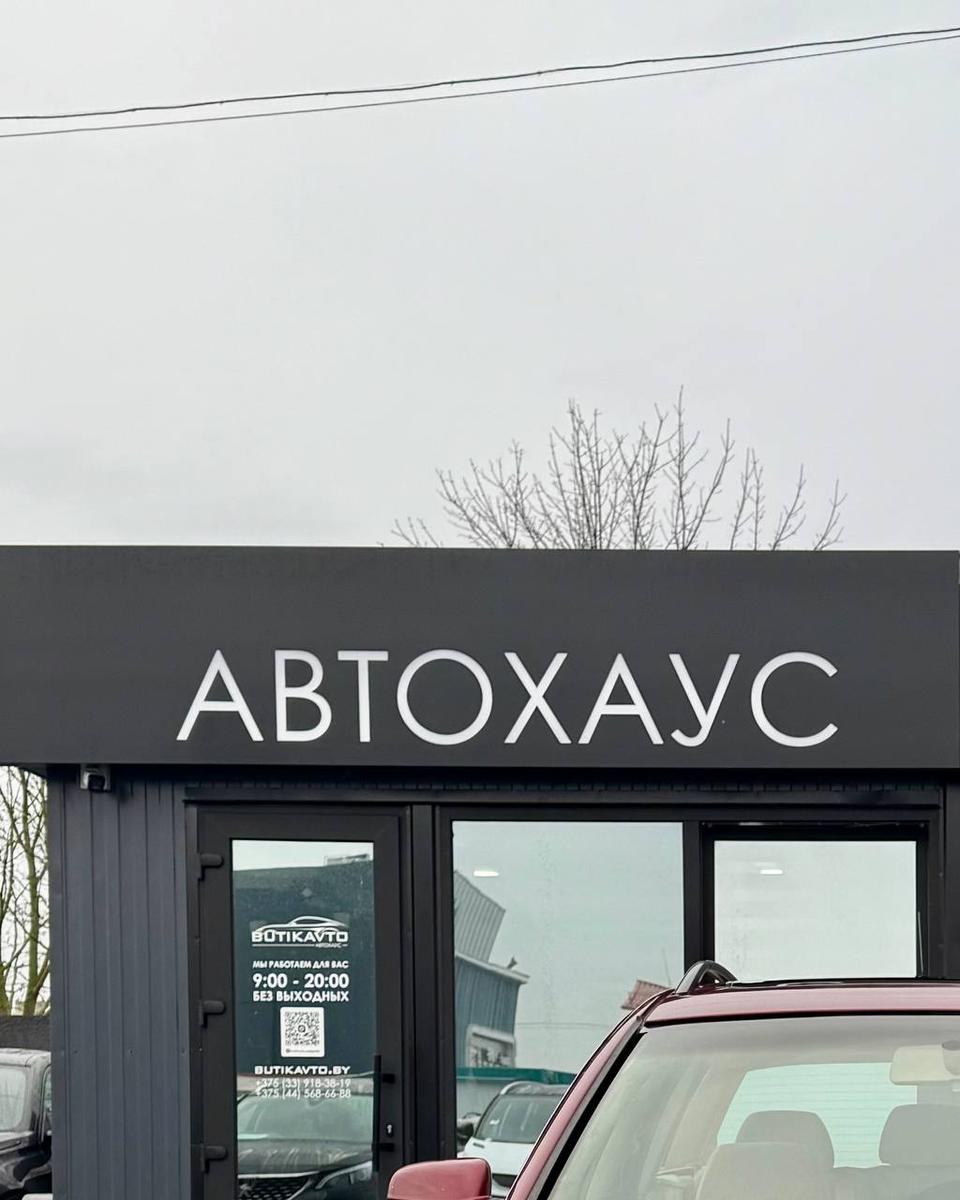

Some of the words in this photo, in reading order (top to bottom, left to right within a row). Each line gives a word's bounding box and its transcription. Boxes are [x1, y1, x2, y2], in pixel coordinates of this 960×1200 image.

[176, 648, 840, 747] АВТОХАУС
[251, 930, 349, 943] BUTIKAVTO
[252, 961, 268, 969] МЫ
[269, 961, 312, 969] РАБОТАЕМ
[313, 961, 330, 969] ДЛЯ
[331, 961, 349, 969] ВАС
[252, 973, 288, 988] 9:00
[304, 973, 350, 989] 20:00
[253, 991, 274, 1002] БЕЗ
[276, 991, 350, 1003] ВЫХОДНЫХ
[254, 1065, 351, 1075] BUTIKAVTO.BY
[282, 1077, 301, 1089] (33)
[303, 1078, 352, 1088] 918-38-19
[282, 1088, 301, 1100] (44)
[304, 1088, 352, 1098] 568-66-88
